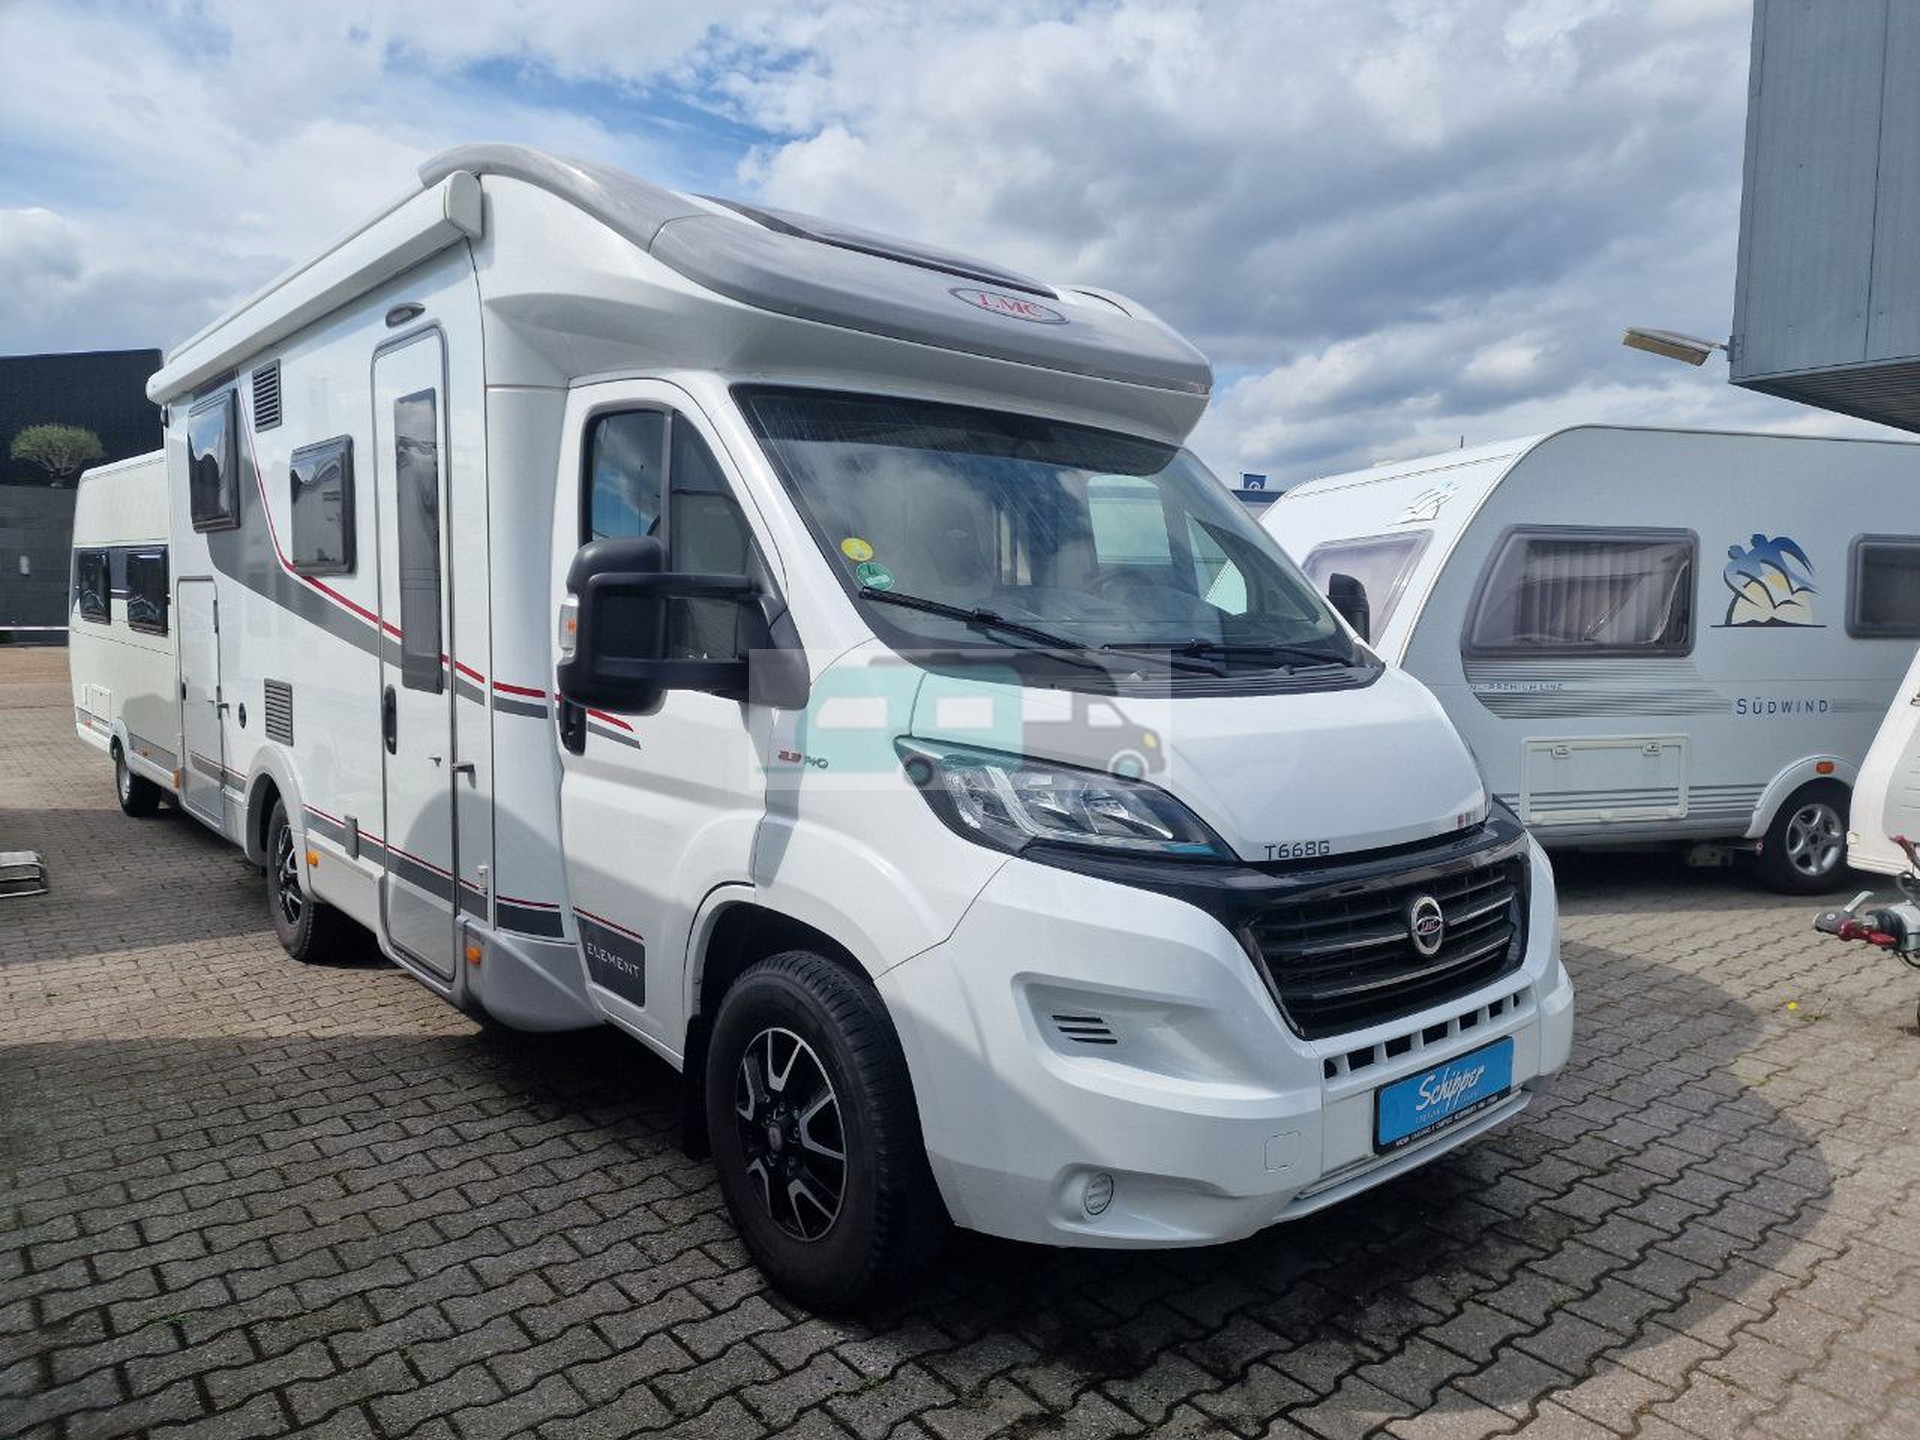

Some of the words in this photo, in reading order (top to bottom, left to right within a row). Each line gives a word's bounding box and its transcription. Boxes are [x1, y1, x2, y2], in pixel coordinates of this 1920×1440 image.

[977, 293, 1043, 318] LMC
[1736, 697, 1828, 715] SÜDWIND
[1264, 840, 1330, 861] T668G
[587, 942, 639, 979] ELEMENT
[1415, 1065, 1485, 1112] Schipper
